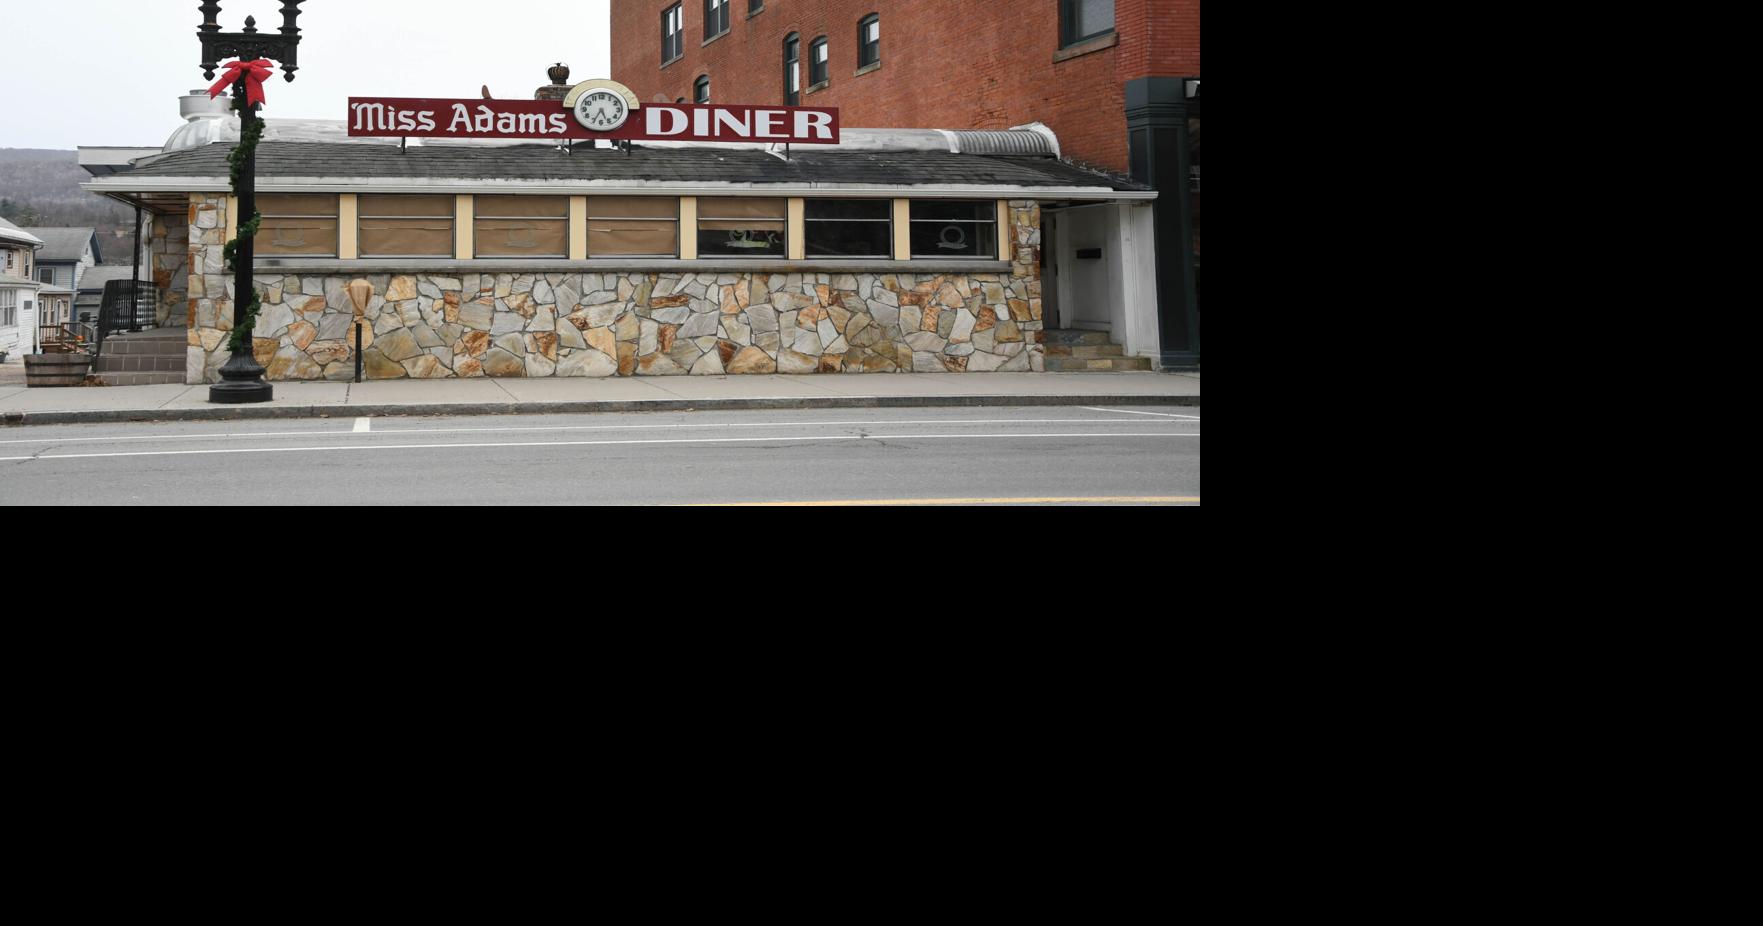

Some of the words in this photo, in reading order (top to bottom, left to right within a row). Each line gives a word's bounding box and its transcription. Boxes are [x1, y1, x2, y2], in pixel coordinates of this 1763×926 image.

[351, 103, 436, 131] Miss
[446, 104, 568, 133] Adams
[645, 107, 834, 139] DINER
